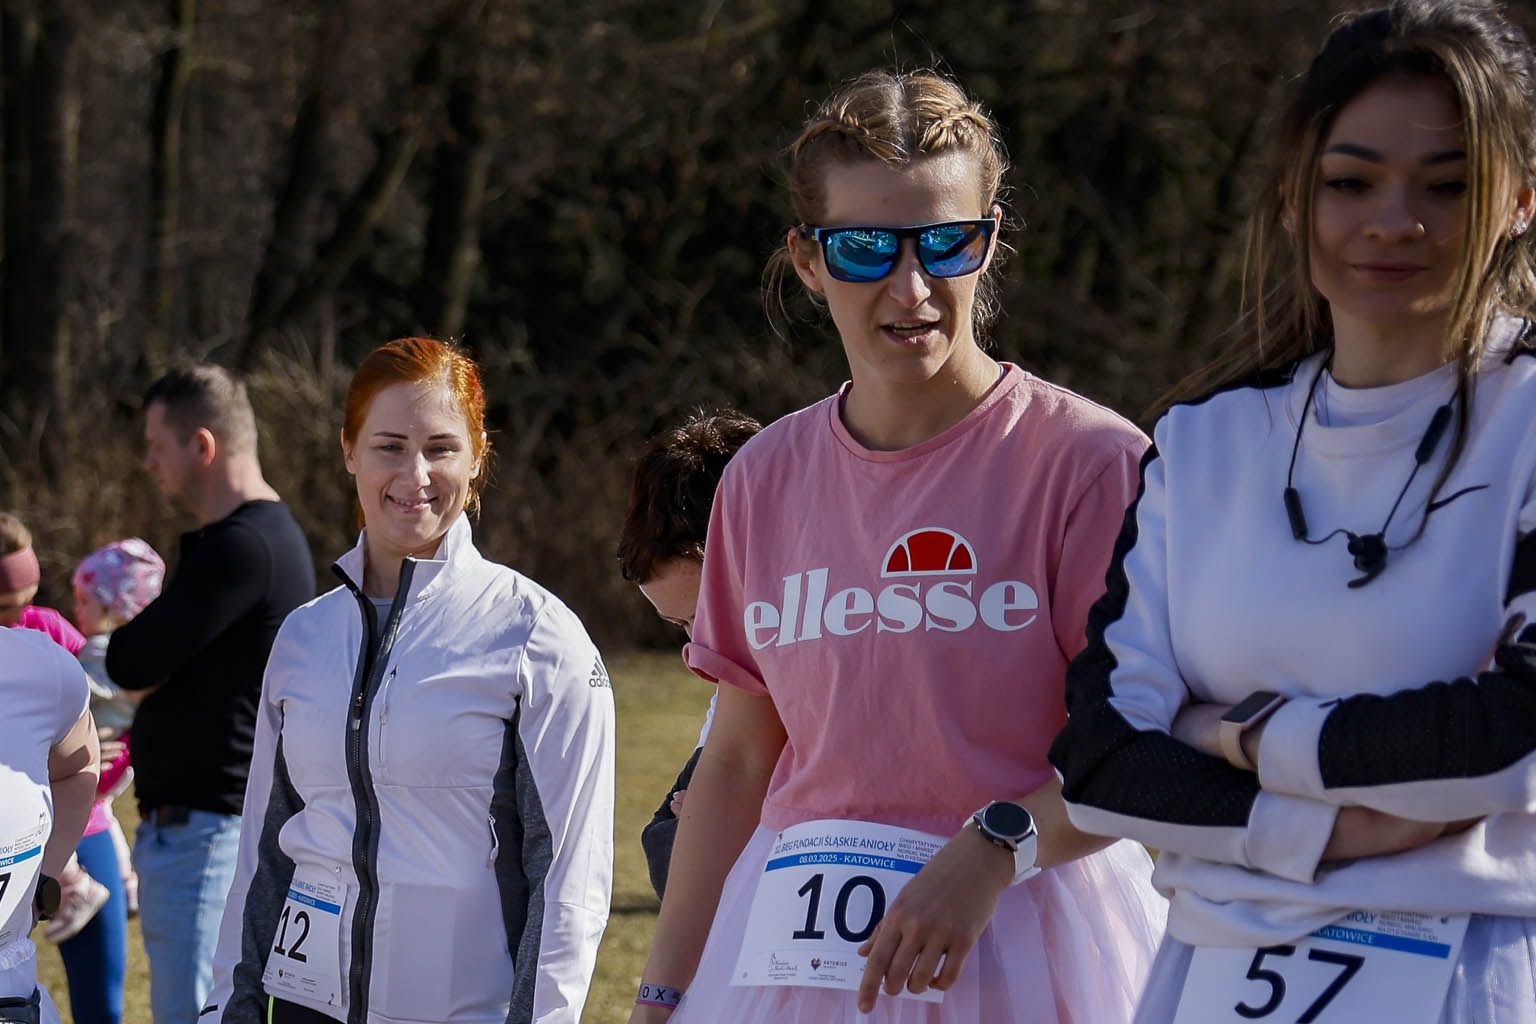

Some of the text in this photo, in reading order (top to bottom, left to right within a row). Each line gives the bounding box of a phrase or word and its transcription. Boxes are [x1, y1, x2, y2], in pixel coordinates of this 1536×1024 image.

[744, 567, 1039, 650] ellesse
[793, 836, 824, 850] FUNDACJI
[824, 833, 858, 848] ŚLĄSKIE
[859, 836, 896, 851] ANIOŁY
[799, 854, 838, 864] 08.03.2025
[844, 854, 896, 868] KATOWICE
[274, 904, 307, 963] 12
[792, 873, 886, 943] 10
